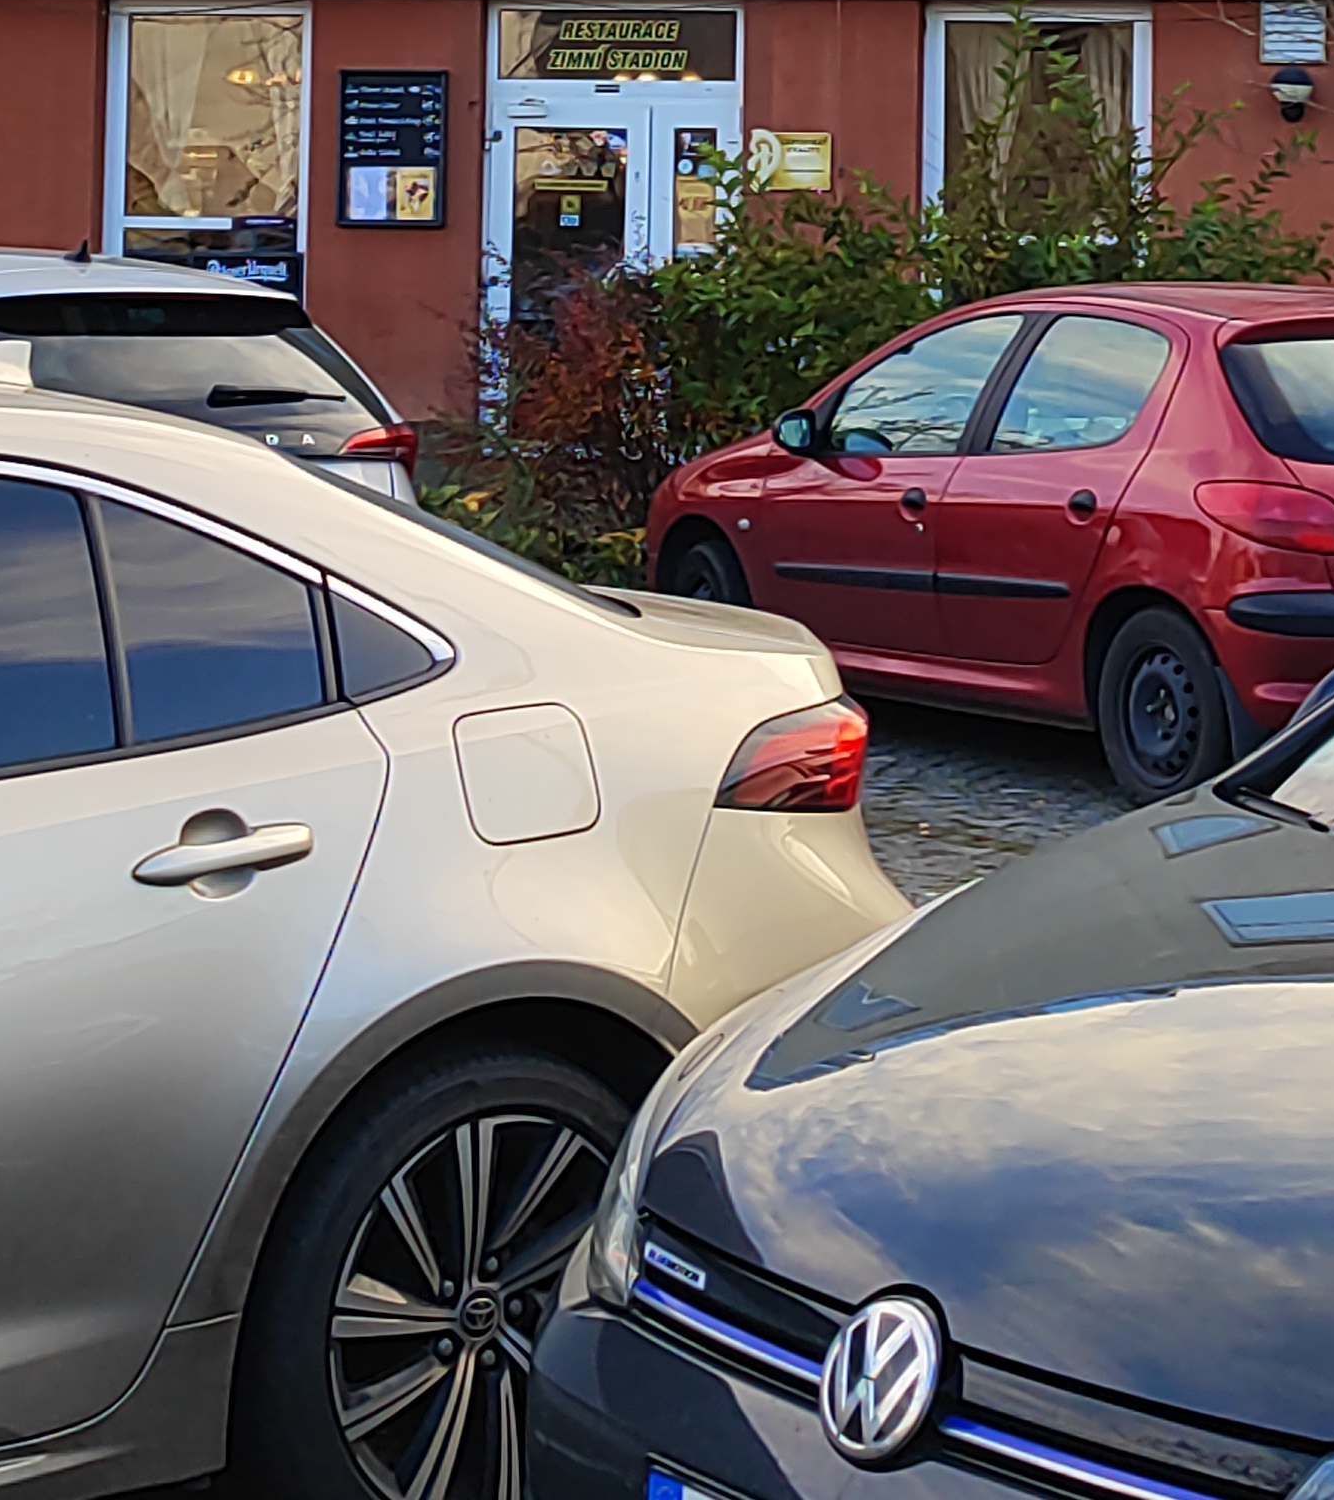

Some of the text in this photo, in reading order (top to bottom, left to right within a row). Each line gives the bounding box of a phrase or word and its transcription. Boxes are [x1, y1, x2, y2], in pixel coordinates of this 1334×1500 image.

[559, 20, 680, 41] RESTAURACE
[547, 44, 687, 70] ZIMNÍ STADION
